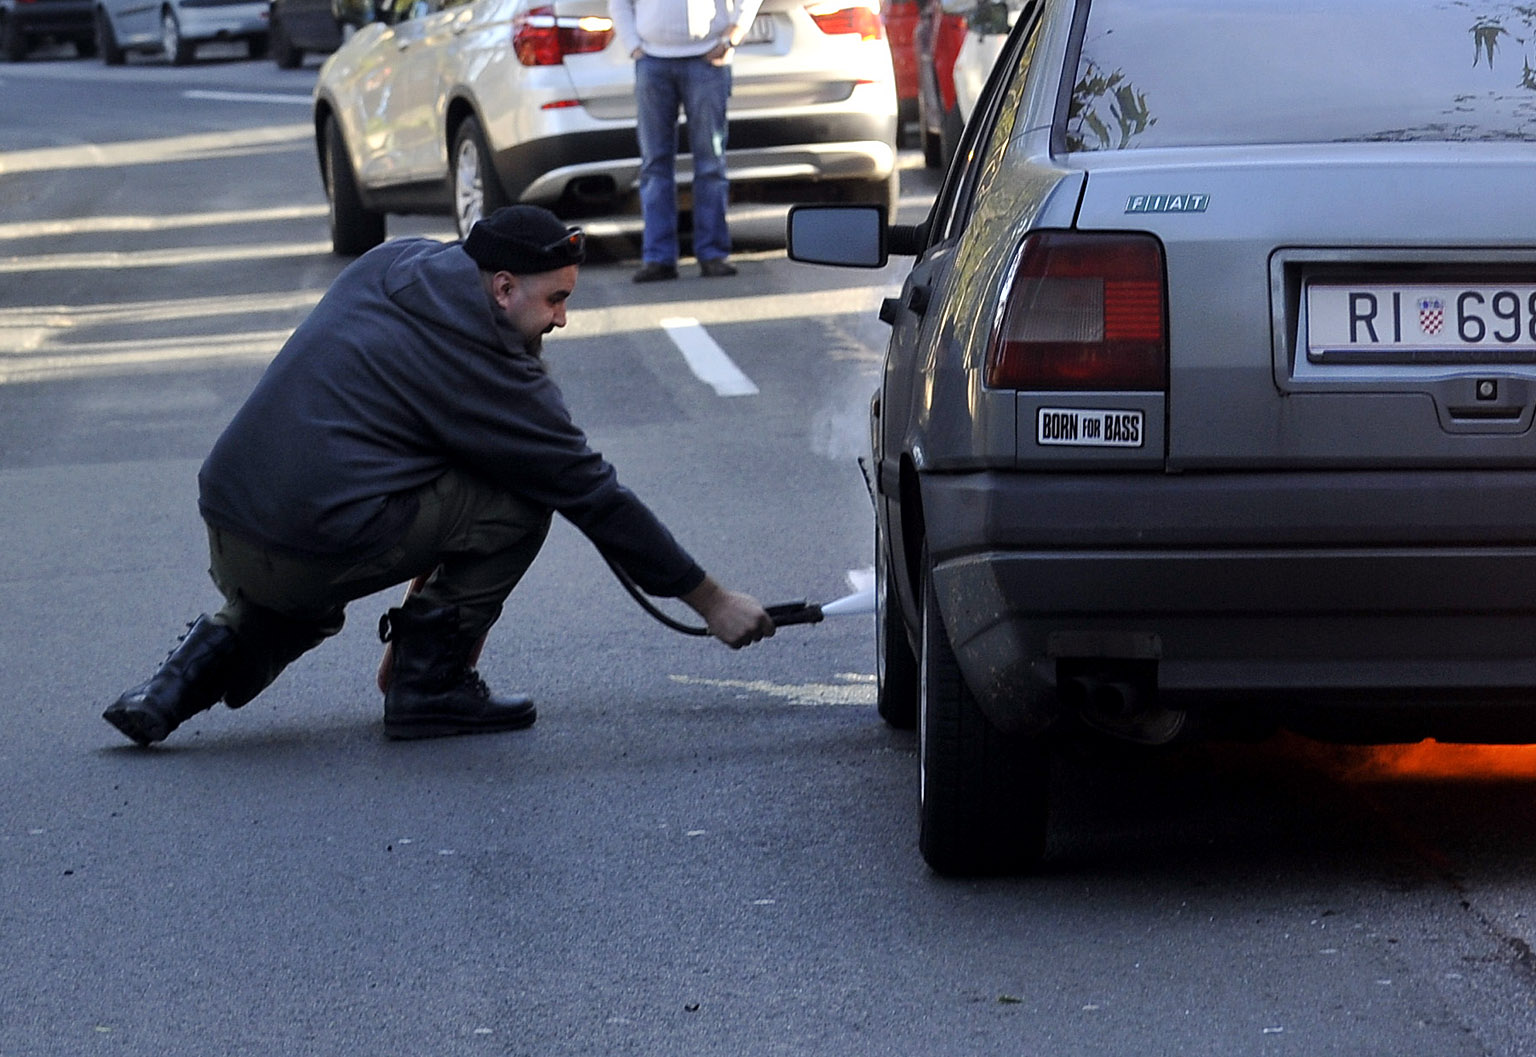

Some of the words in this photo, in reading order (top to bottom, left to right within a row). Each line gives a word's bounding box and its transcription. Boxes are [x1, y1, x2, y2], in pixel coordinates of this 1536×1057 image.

[1131, 194, 1204, 211] FIAT
[1348, 291, 1401, 344] RI
[1042, 413, 1079, 440] BORN
[1082, 418, 1101, 439] FOR
[1104, 414, 1140, 442] BASS
